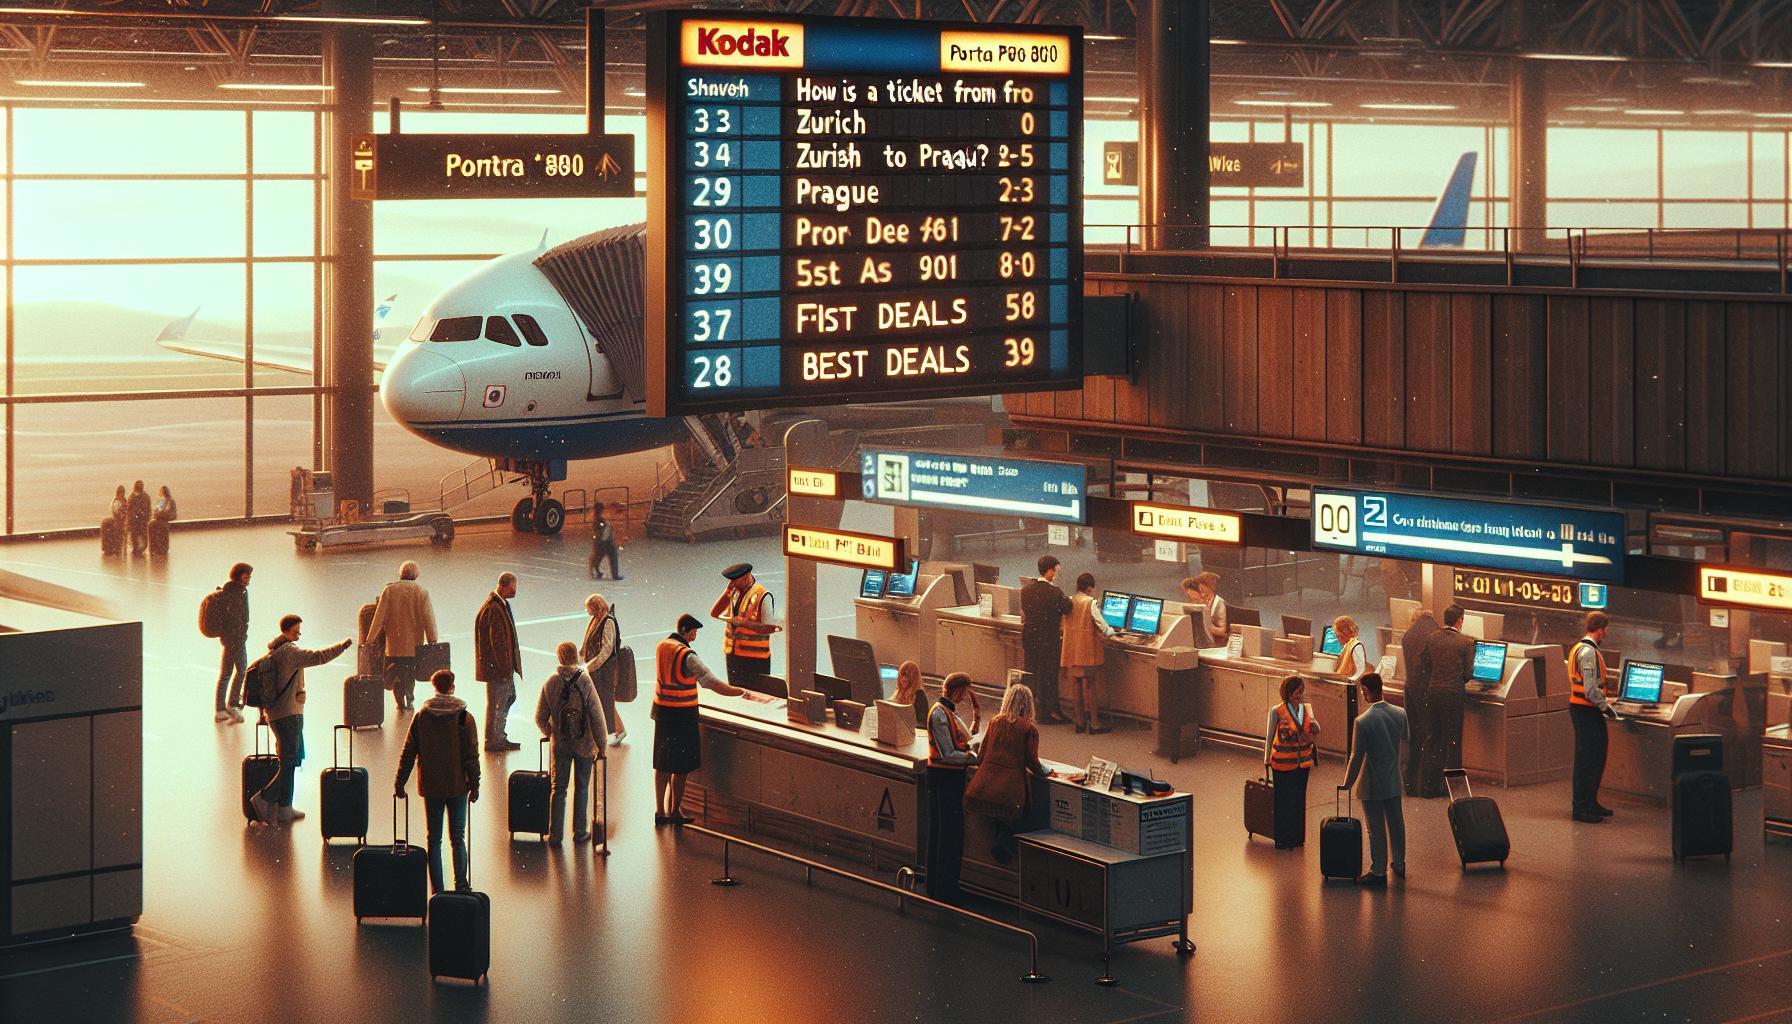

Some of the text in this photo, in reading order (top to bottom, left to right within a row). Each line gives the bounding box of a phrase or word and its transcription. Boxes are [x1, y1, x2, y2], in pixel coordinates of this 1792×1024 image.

[697, 27, 791, 58] Kodak
[796, 78, 836, 102] How
[842, 80, 857, 103] is
[867, 86, 878, 102] a
[953, 80, 996, 104] from
[1004, 80, 1034, 104] fro
[693, 108, 732, 134] 33
[796, 108, 866, 134] Zurich
[1020, 112, 1034, 134] 0
[446, 154, 524, 178] Pontra
[693, 142, 732, 167] 34
[883, 145, 907, 168] to
[692, 178, 732, 207] 29
[796, 178, 880, 212] Prague
[693, 219, 733, 250] 30
[866, 217, 910, 244] Dee
[693, 263, 733, 295] 39
[860, 256, 892, 284] As
[878, 298, 968, 331] DEALS
[1005, 292, 1036, 322] 58
[693, 310, 732, 342] 37
[803, 346, 970, 381] BEST DEALS
[1004, 338, 1036, 368] 39
[693, 355, 732, 388] 28
